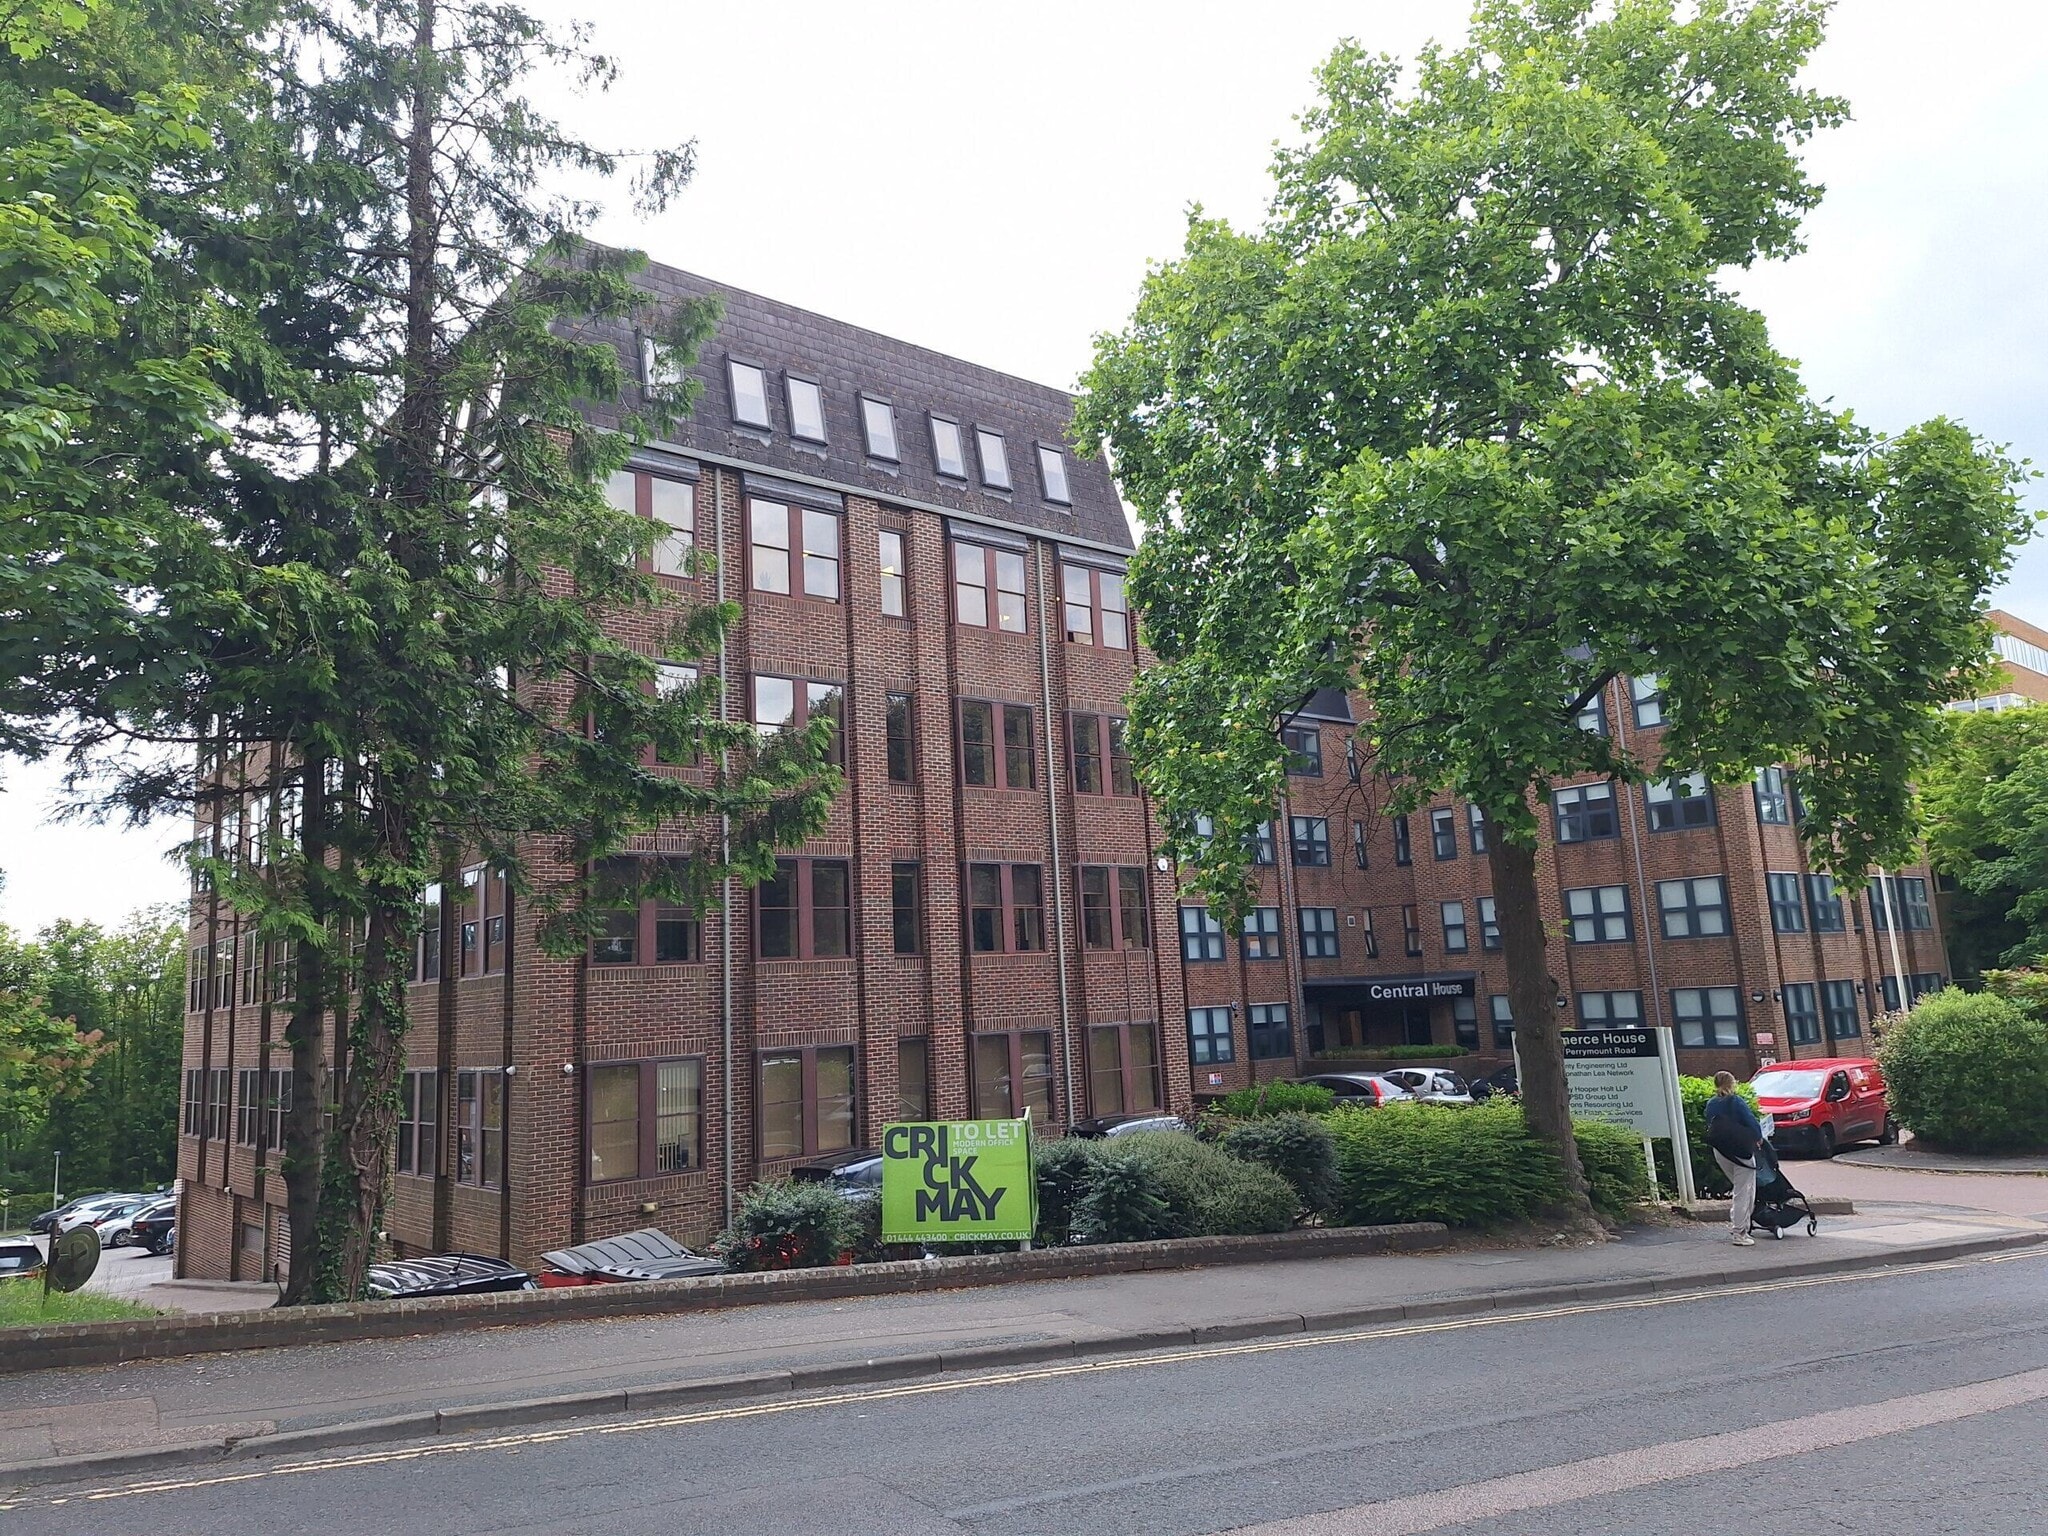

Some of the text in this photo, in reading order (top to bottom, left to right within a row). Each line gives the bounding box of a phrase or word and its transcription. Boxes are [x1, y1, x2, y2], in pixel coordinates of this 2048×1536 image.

[1370, 982, 1463, 999] Central House
[1561, 1033, 1646, 1045] merce House
[1565, 1046, 1636, 1056] Perrymount Road
[1584, 1101, 1621, 1109] Resourcing
[951, 1122, 1022, 1139] TO LET
[952, 1138, 1014, 1147] MODERN OFFICE
[952, 1147, 978, 1155] SPACE
[916, 1188, 1007, 1222] MAY
[886, 1231, 1029, 1242] 01444 443400 CRICKMAY.CO.UK
